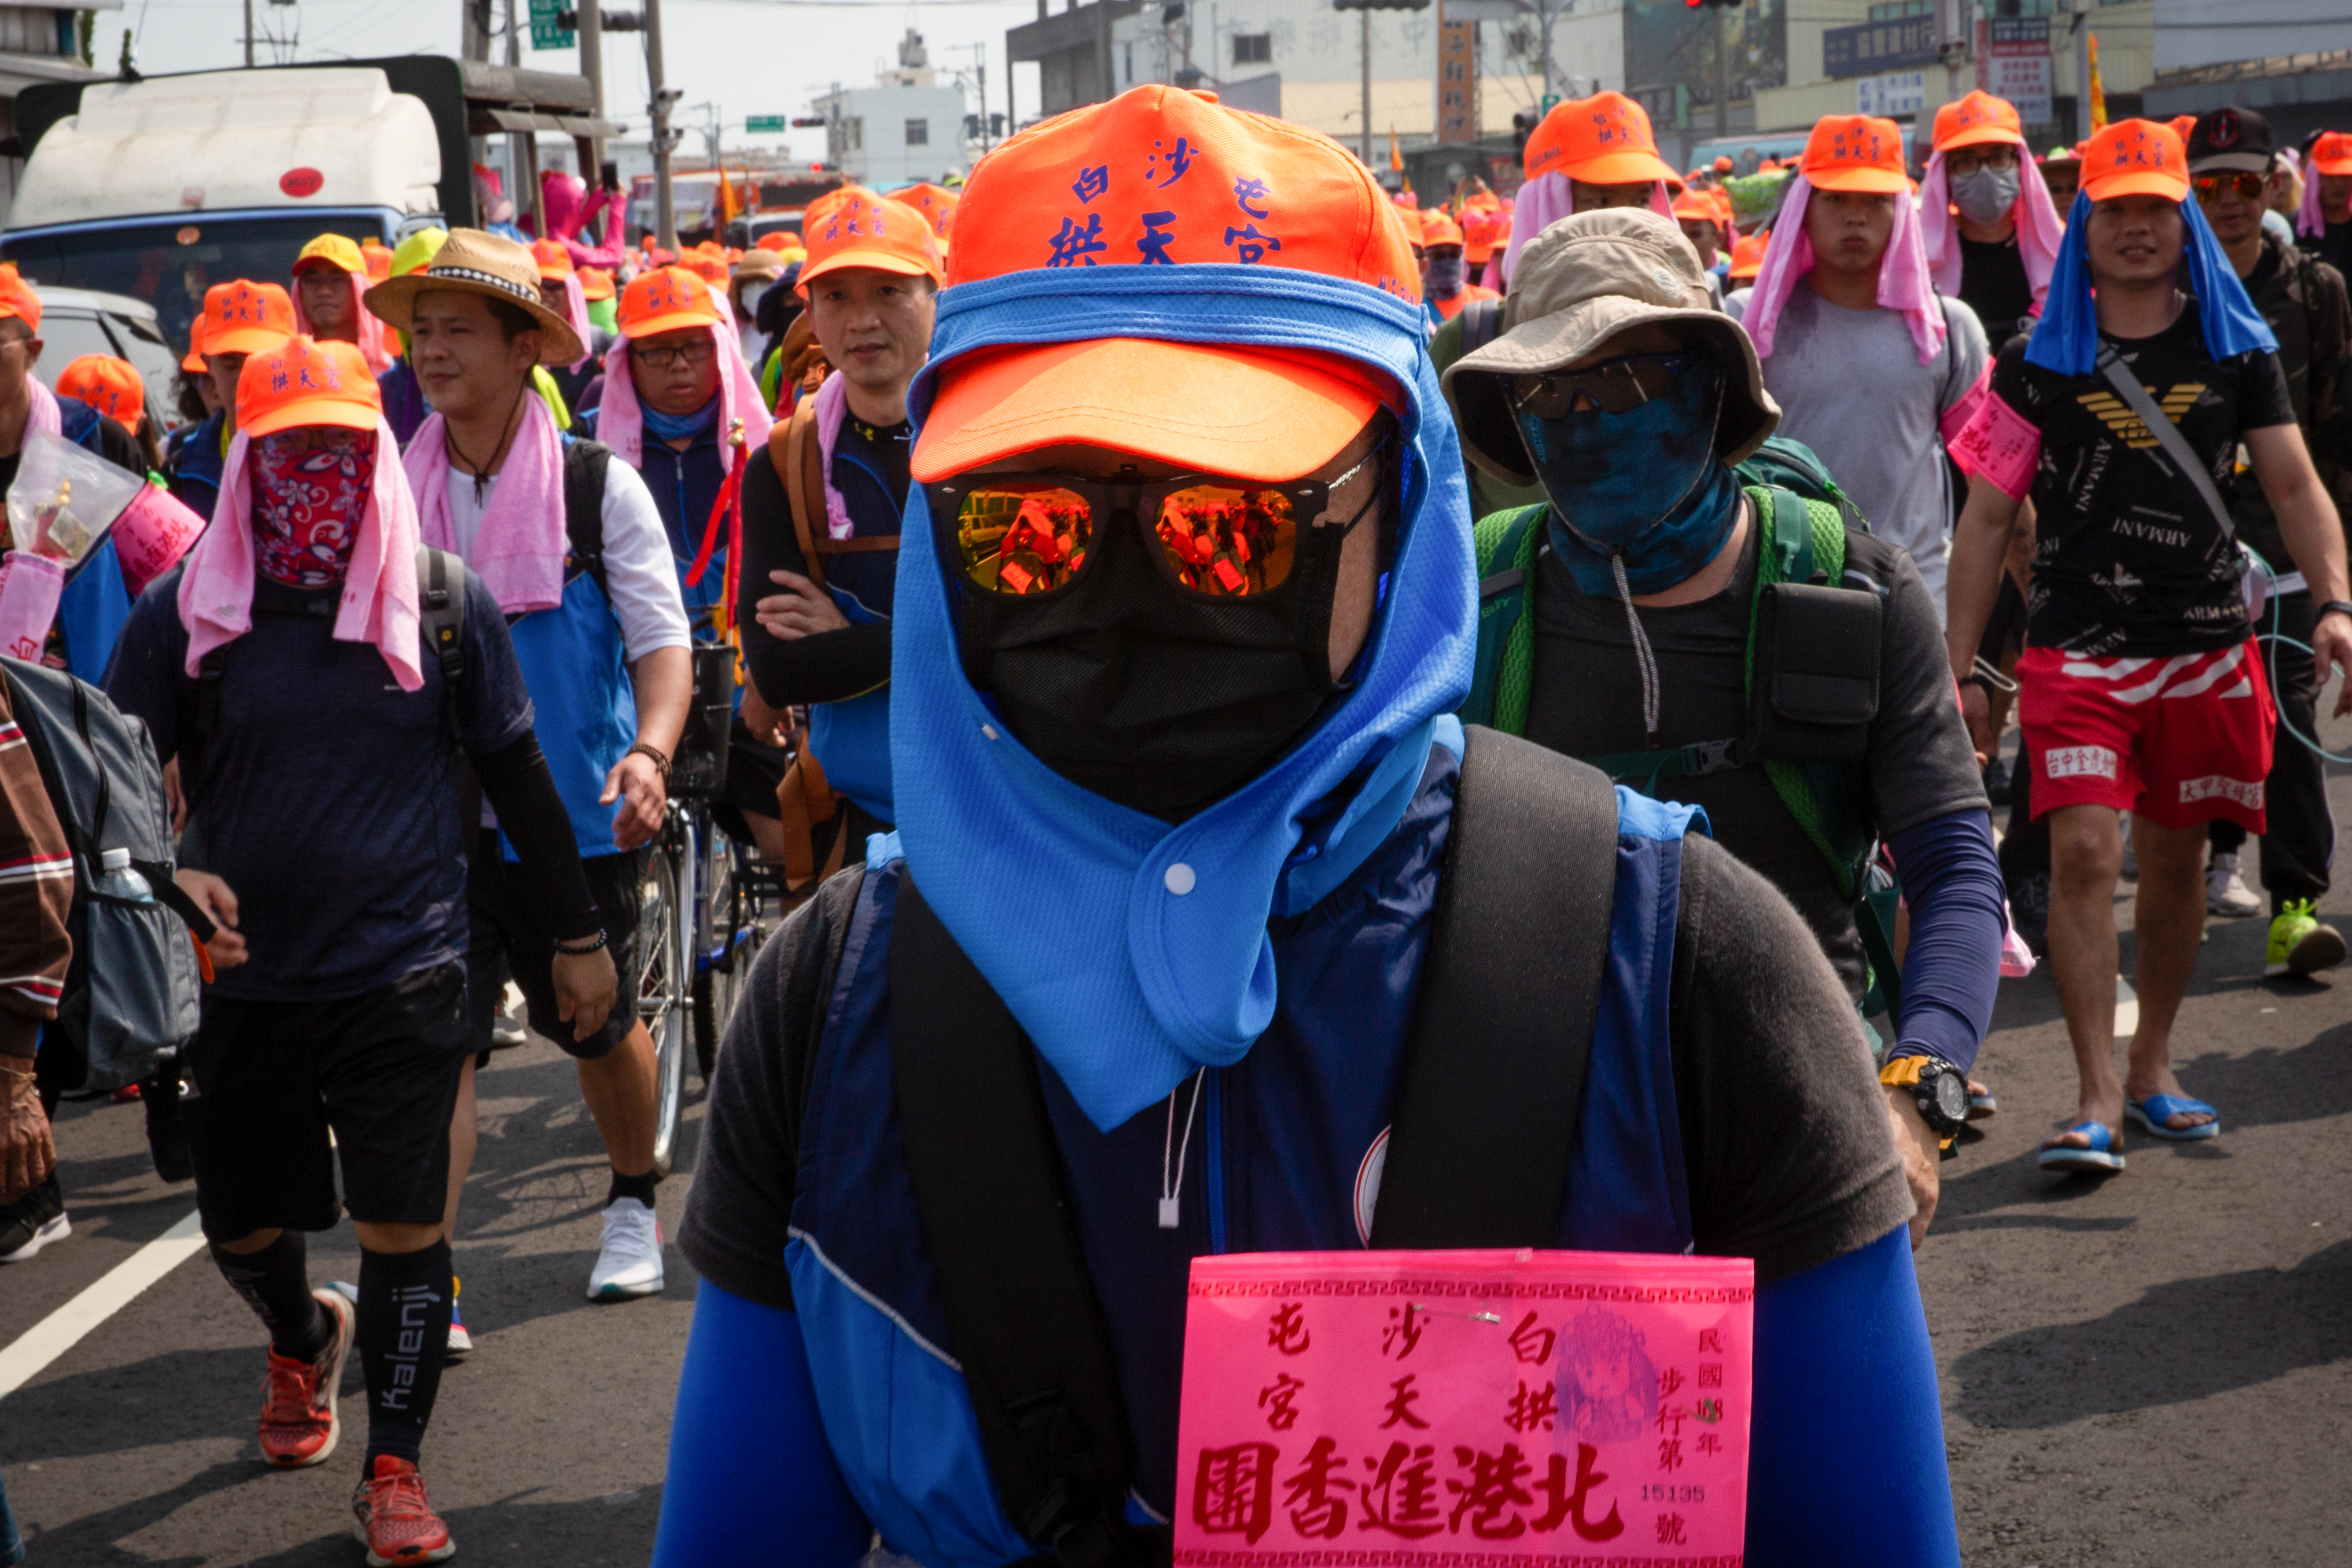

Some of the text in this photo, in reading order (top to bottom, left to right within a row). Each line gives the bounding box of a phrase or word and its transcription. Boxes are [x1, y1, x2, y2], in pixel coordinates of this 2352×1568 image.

[1072, 137, 1272, 219] 白沙屯
[2075, 438, 2112, 511] ARMANI
[2112, 517, 2192, 548] ARMANI
[1258, 1372, 1559, 1433] 拱天宮
[1193, 1436, 1625, 1544] 北港進香團
[1641, 1483, 1705, 1503] 15135
